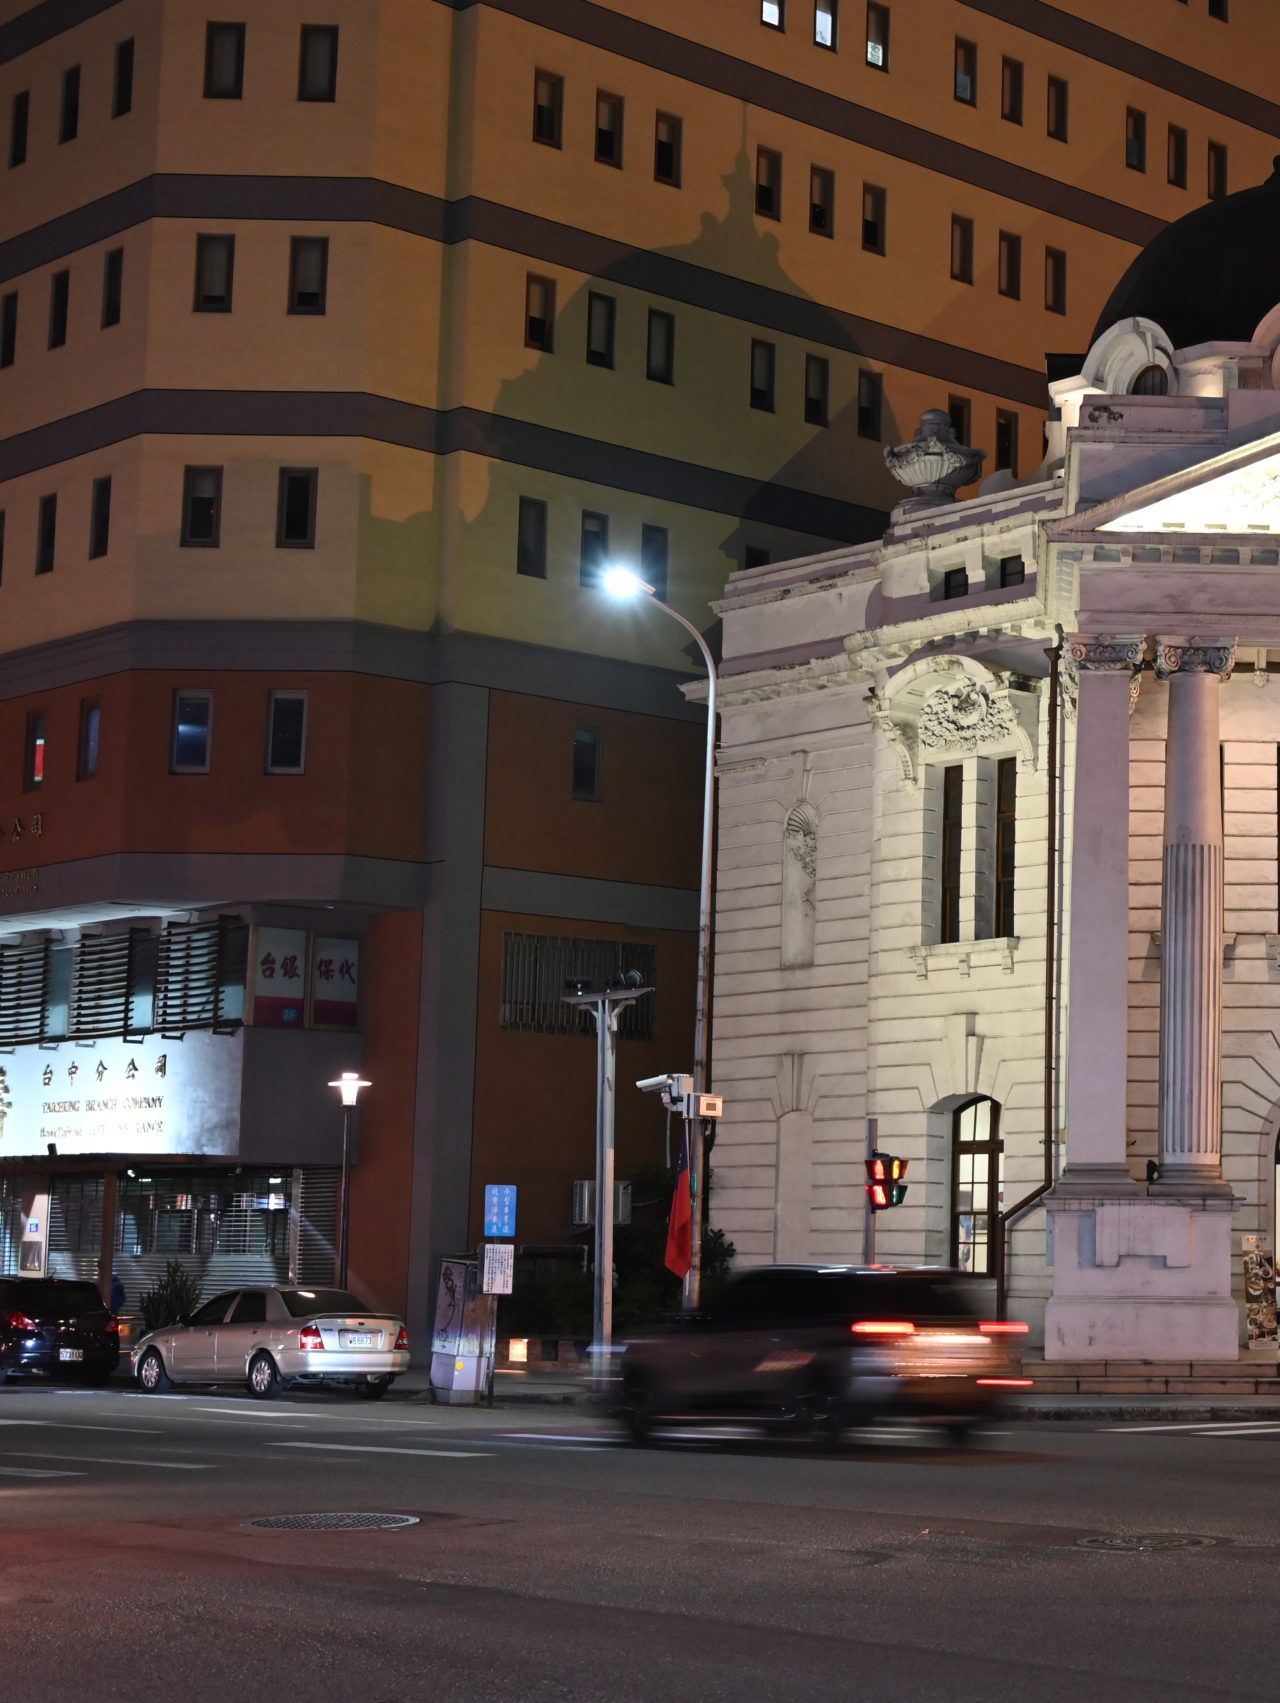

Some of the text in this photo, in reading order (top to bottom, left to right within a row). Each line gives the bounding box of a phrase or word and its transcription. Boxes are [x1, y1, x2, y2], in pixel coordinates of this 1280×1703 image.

[260, 952, 300, 979] 台銀
[42, 1053, 167, 1087] 台中分公司
